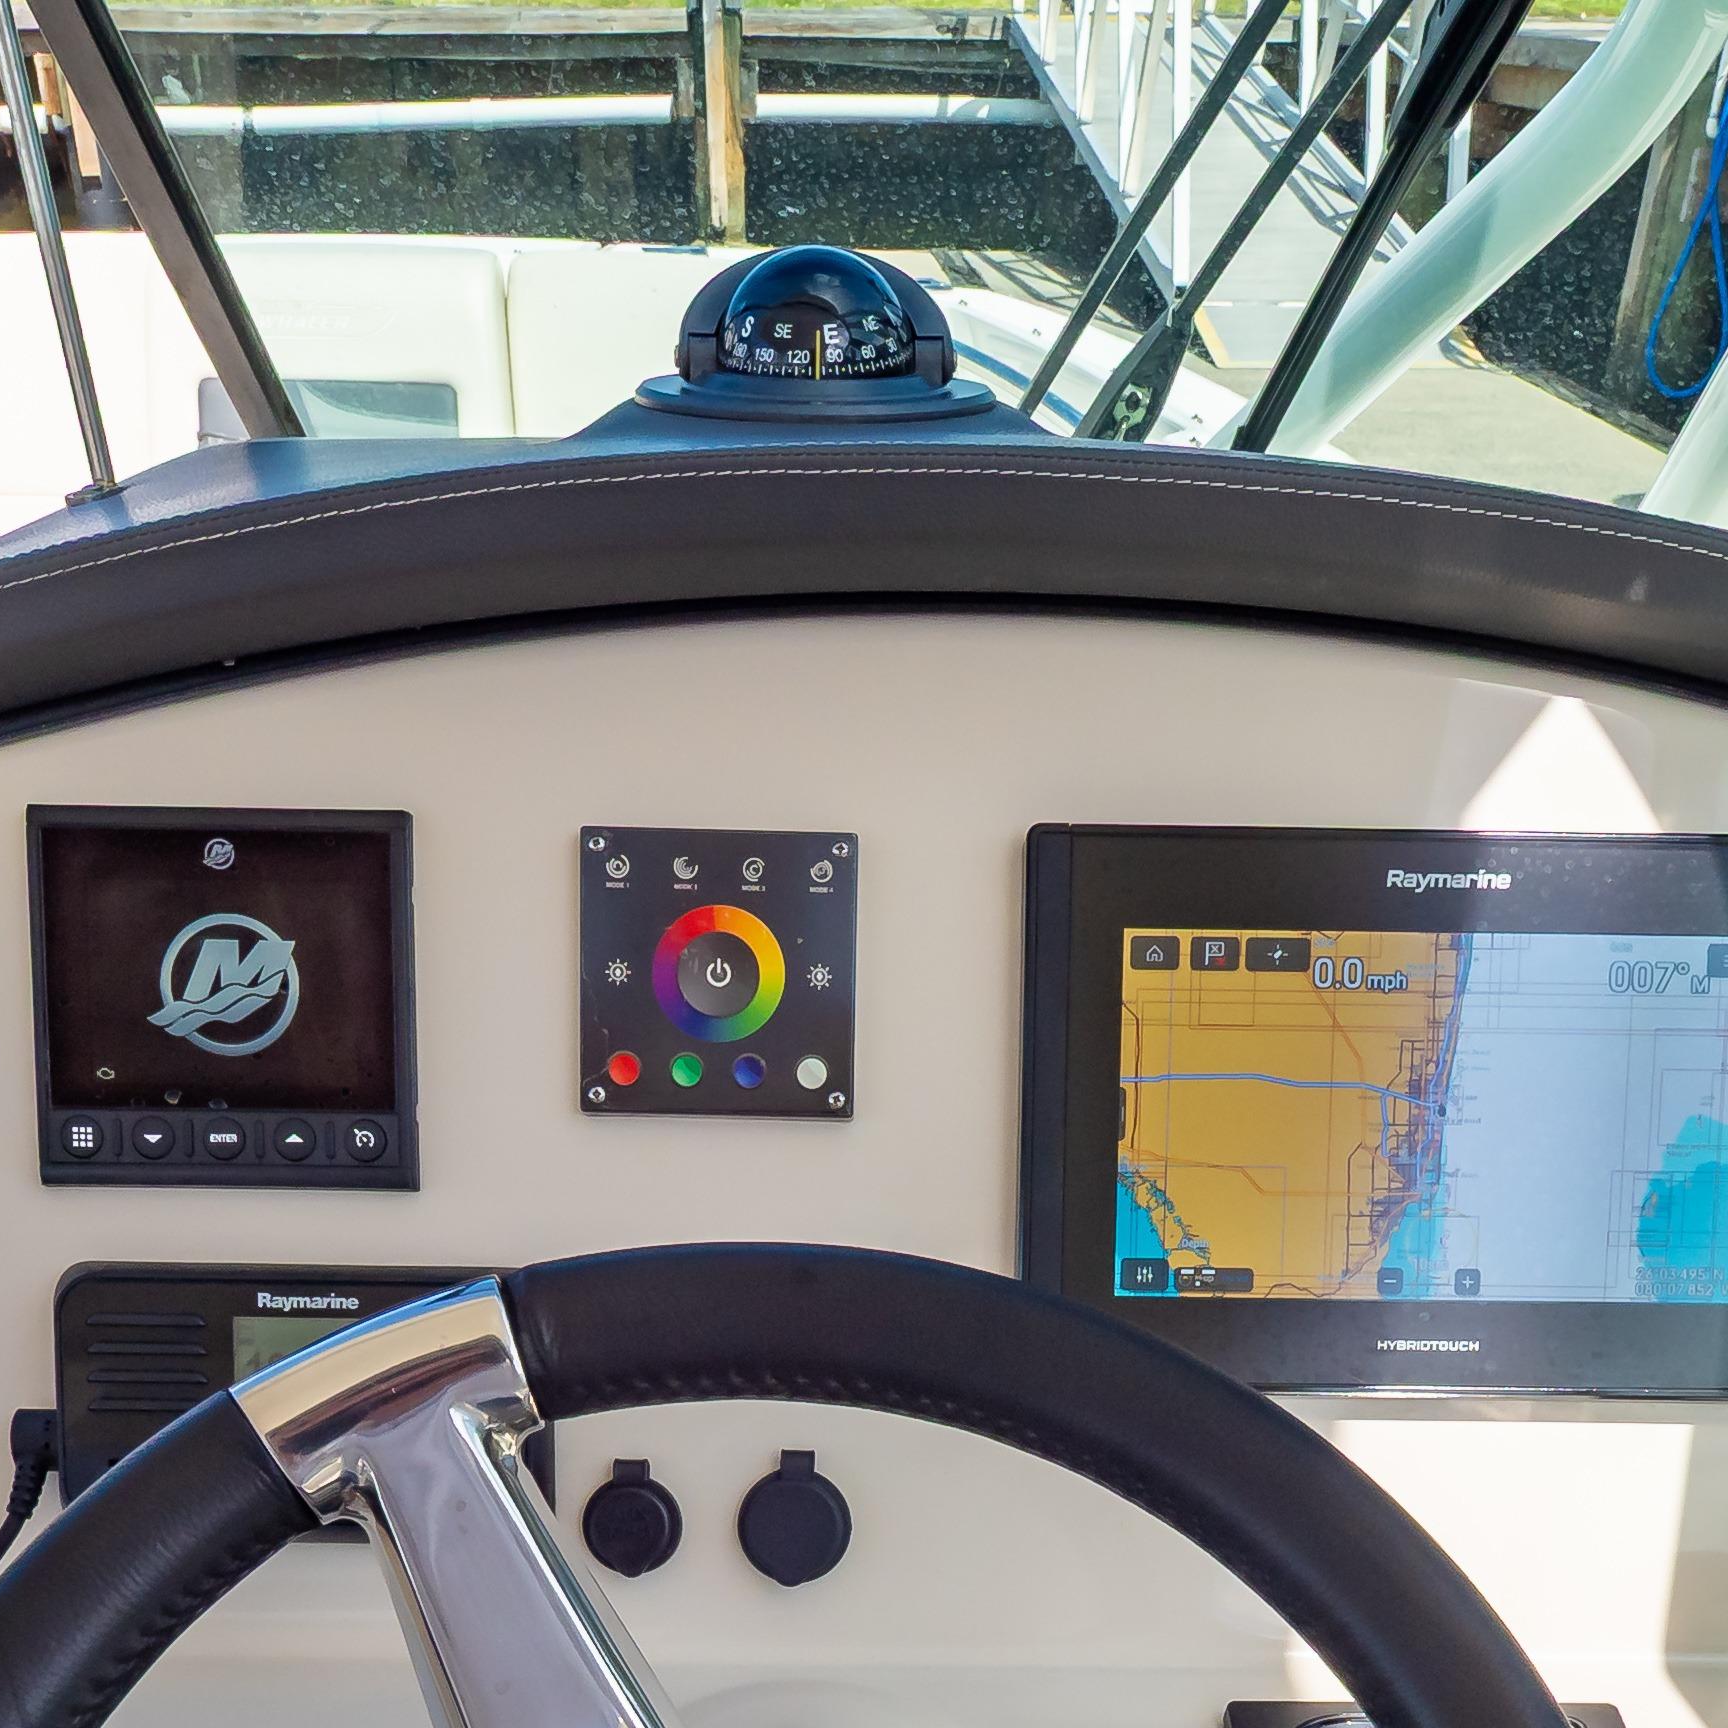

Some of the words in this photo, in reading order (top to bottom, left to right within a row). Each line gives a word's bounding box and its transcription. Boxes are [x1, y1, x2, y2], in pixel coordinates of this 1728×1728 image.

[741, 316, 755, 338] S
[774, 323, 793, 339] SE
[823, 323, 840, 345] E
[755, 347, 774, 362] 150
[787, 349, 810, 364] 120
[825, 348, 844, 362] 90
[861, 344, 876, 359] 60
[1386, 868, 1512, 893] Raymarine
[1312, 956, 1364, 989] 0.0
[1366, 970, 1408, 993] mph
[257, 1291, 360, 1311] Raymarine
[1377, 1339, 1480, 1353] HYBRIDTOUCH
